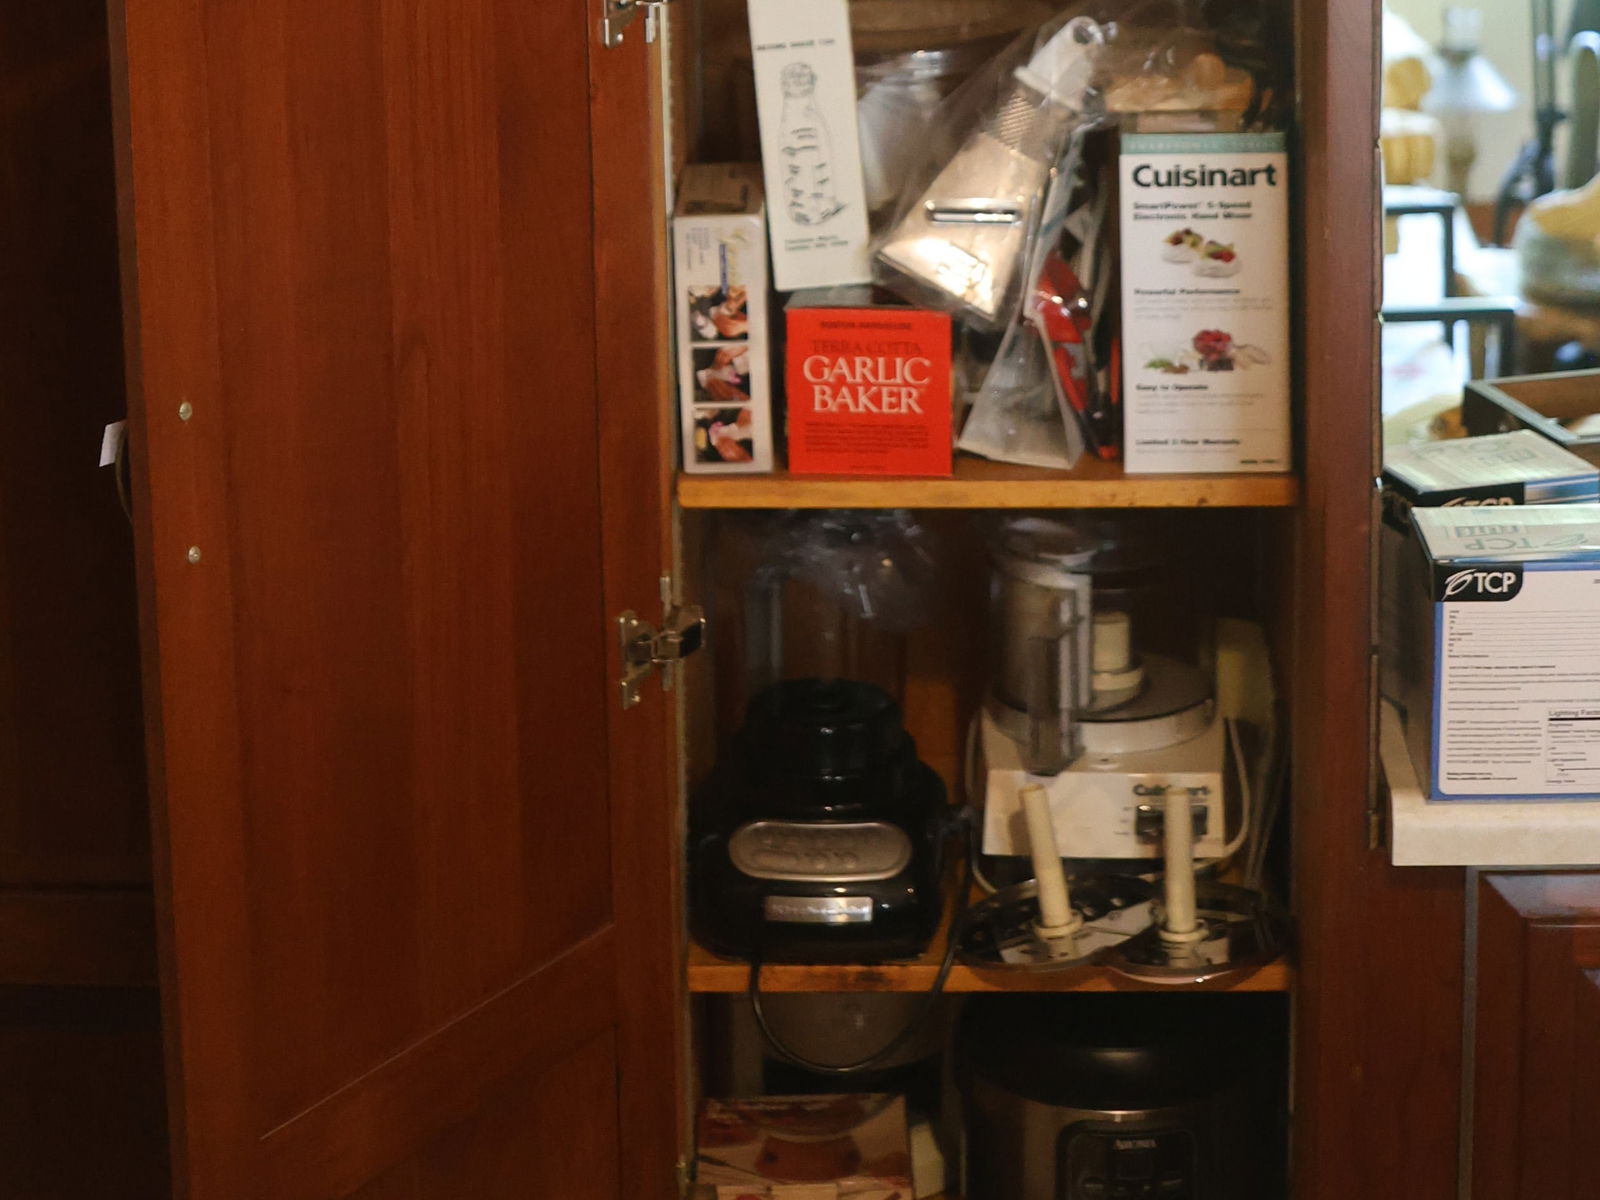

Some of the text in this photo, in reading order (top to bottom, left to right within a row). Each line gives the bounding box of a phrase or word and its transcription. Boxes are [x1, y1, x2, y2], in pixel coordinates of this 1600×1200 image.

[1132, 163, 1277, 188] Cuisinart
[803, 355, 932, 385] GARLIC
[813, 384, 924, 414] BAKER
[1475, 571, 1517, 594] TCP
